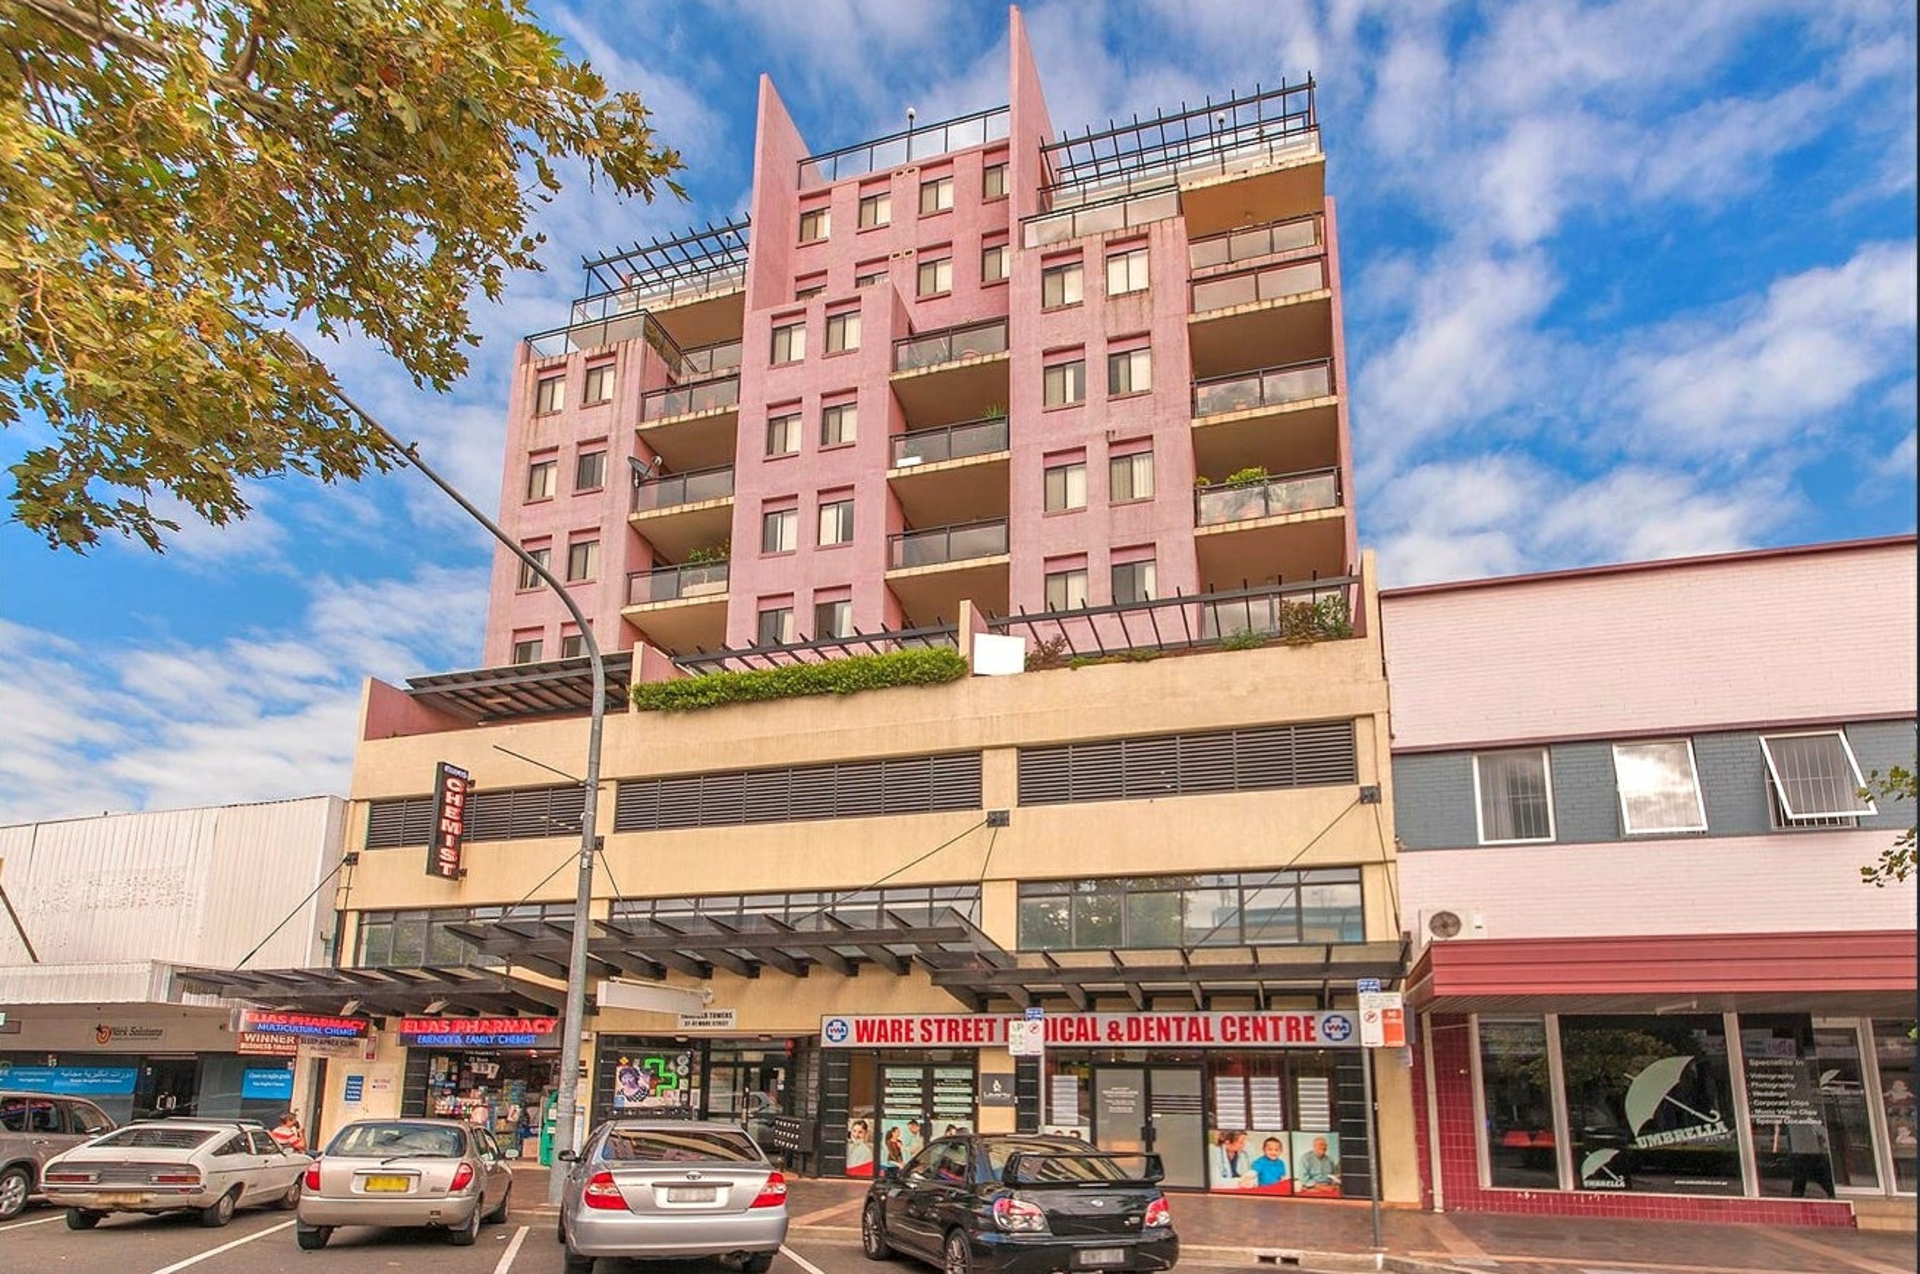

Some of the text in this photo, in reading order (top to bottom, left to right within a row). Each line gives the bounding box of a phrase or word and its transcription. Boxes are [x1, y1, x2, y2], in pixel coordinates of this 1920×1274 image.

[439, 777, 465, 876] CHEMIST
[257, 1023, 358, 1036] MULTICULTURAL CHEMIST
[289, 1014, 367, 1030] PHARMACY
[401, 1018, 558, 1034] ELIAS PHARMACY
[855, 1018, 915, 1043] WARE
[926, 1018, 998, 1043] STREET
[1003, 1016, 1101, 1042] ICAL
[1107, 1020, 1124, 1042] &
[1127, 1016, 1214, 1042] DENTAL
[1220, 1015, 1317, 1042] CENTRE
[244, 1033, 295, 1044] WINNER
[465, 1035, 496, 1045] FAMILY
[497, 1034, 537, 1045] CHEMIST
[1636, 1121, 1729, 1149] UMBRELLA
[1583, 1180, 1626, 1188] UMBRELLA
